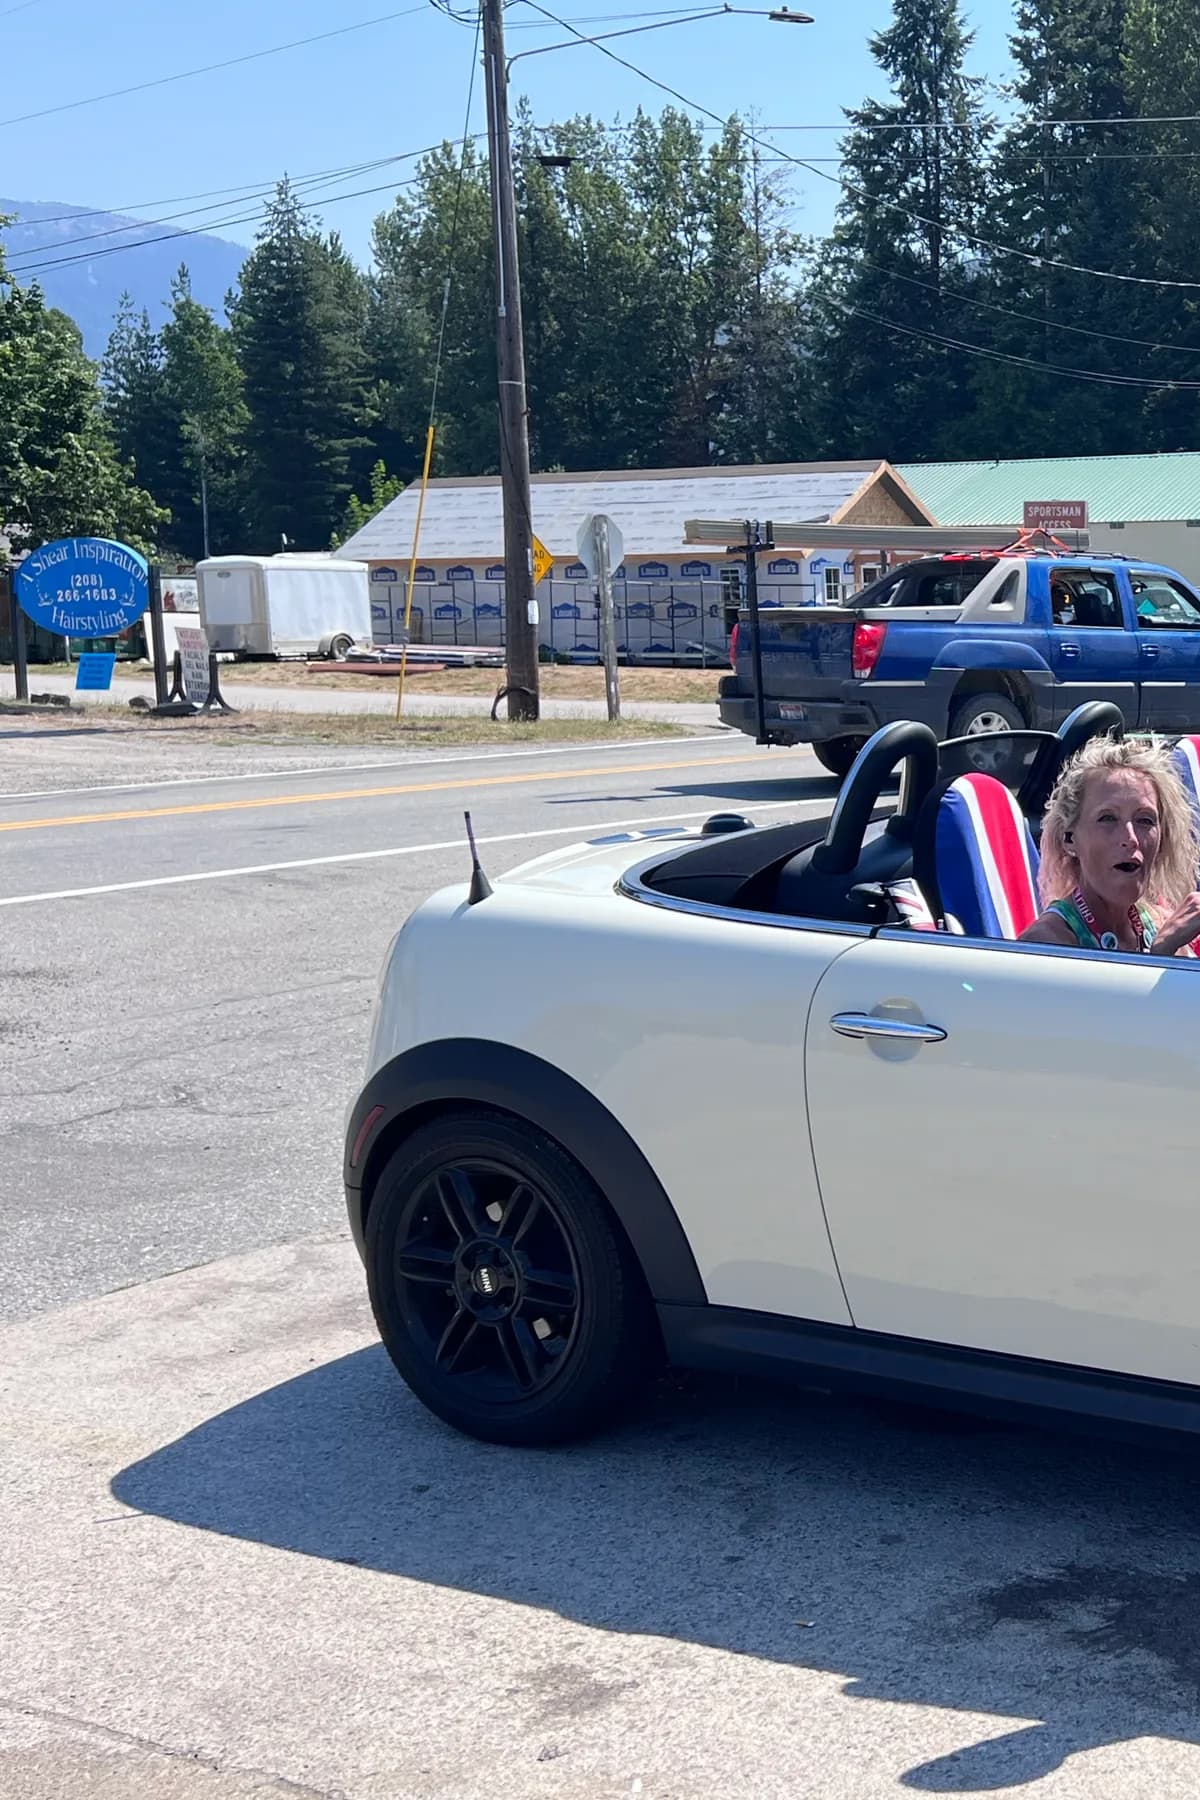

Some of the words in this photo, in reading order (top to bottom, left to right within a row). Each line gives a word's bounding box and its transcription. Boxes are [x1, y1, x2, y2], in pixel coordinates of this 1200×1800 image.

[1028, 506, 1081, 517] SPORTSMAN
[31, 545, 69, 576] Shear
[70, 574, 103, 589] (208)
[51, 605, 129, 636] Hairstyling
[479, 1268, 493, 1293] MINI
